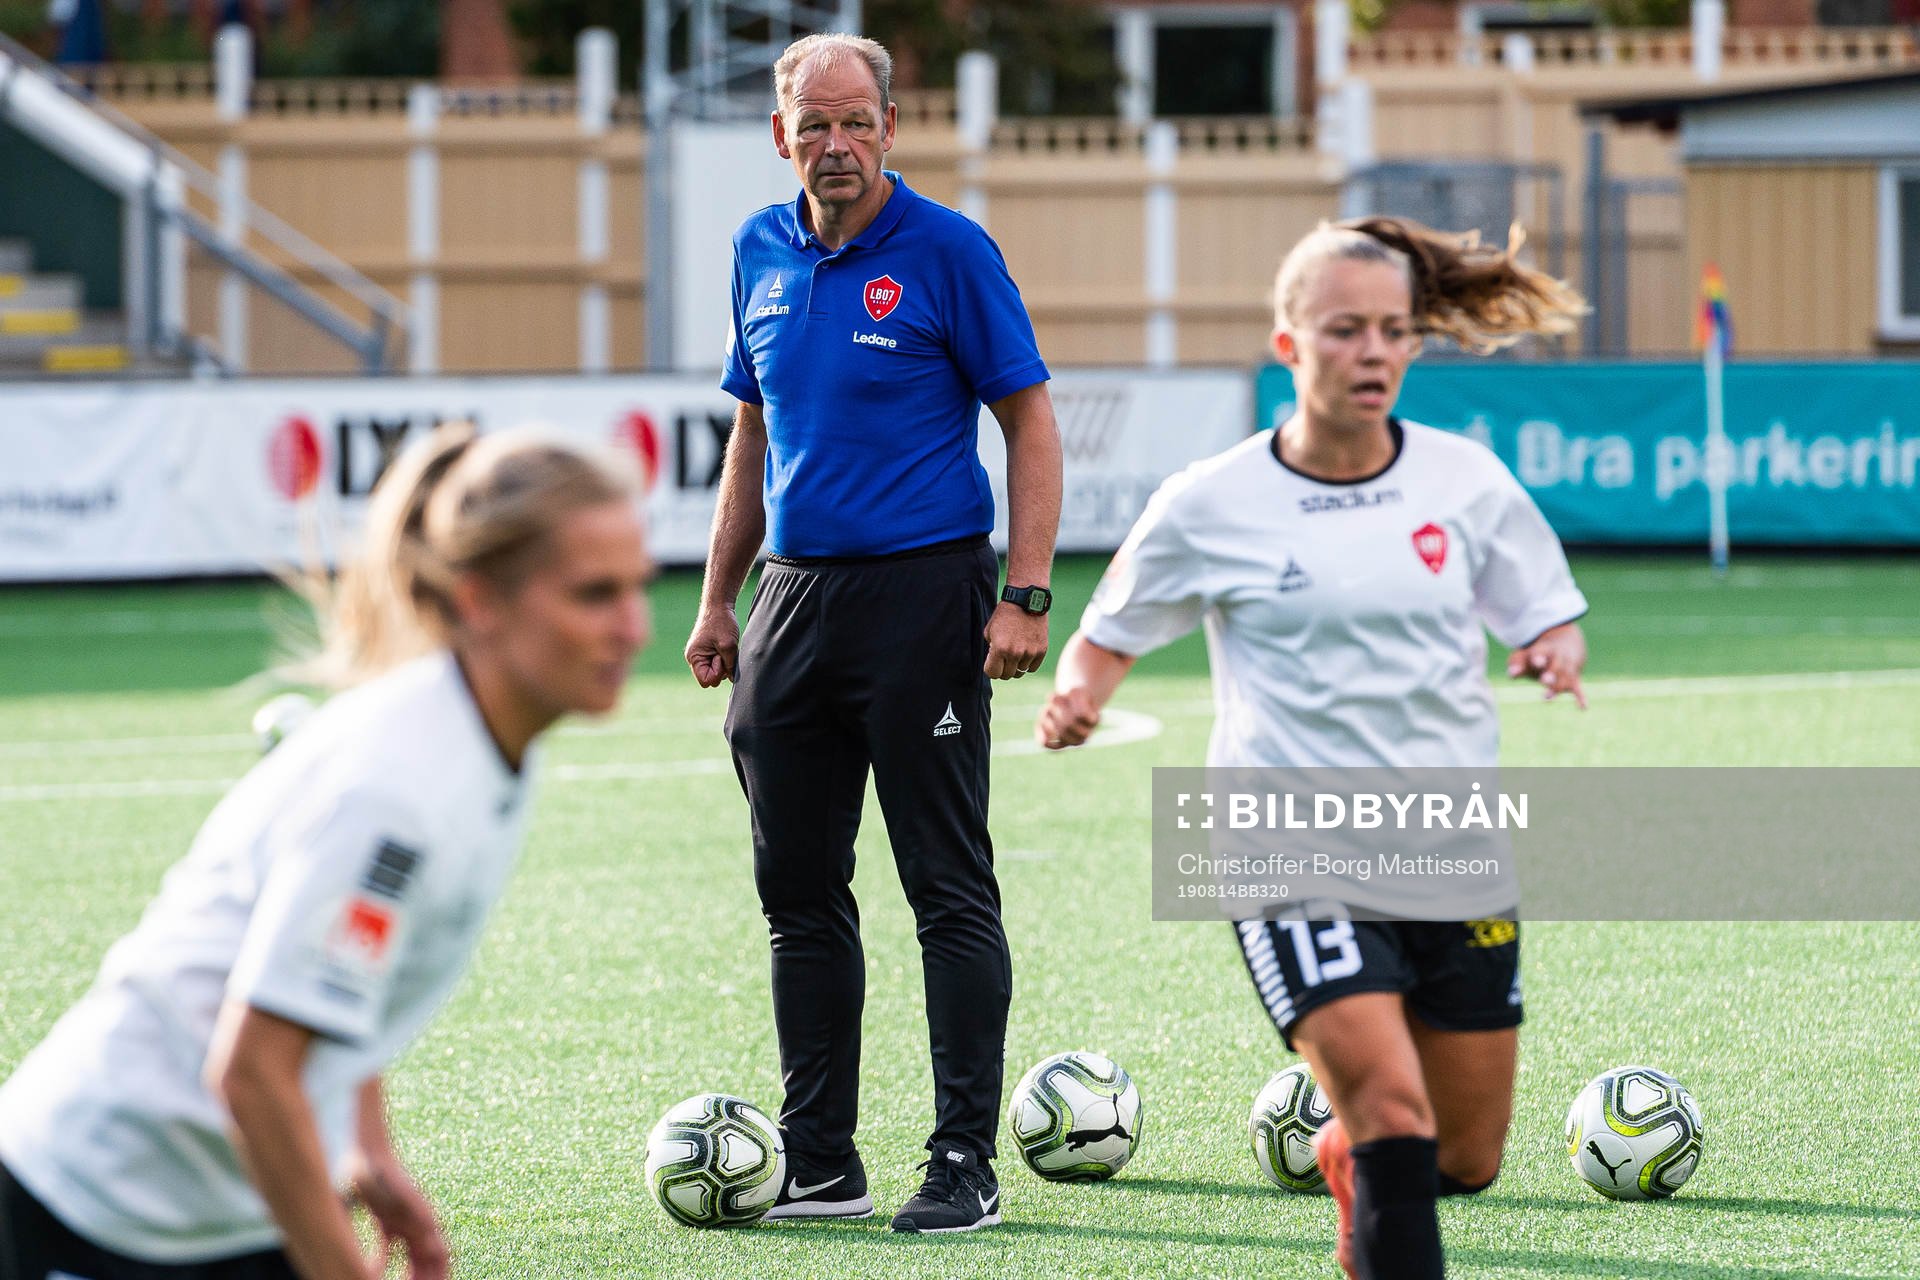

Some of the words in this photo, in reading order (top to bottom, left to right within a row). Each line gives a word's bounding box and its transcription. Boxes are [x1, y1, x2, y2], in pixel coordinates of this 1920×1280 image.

[870, 287, 895, 302] LB07
[853, 331, 897, 348] Ledare
[1517, 420, 1634, 488] Bra
[1298, 488, 1404, 513] stadium
[933, 725, 962, 737] SELECT
[1277, 899, 1363, 987] 13
[946, 1150, 966, 1163] NIKE
